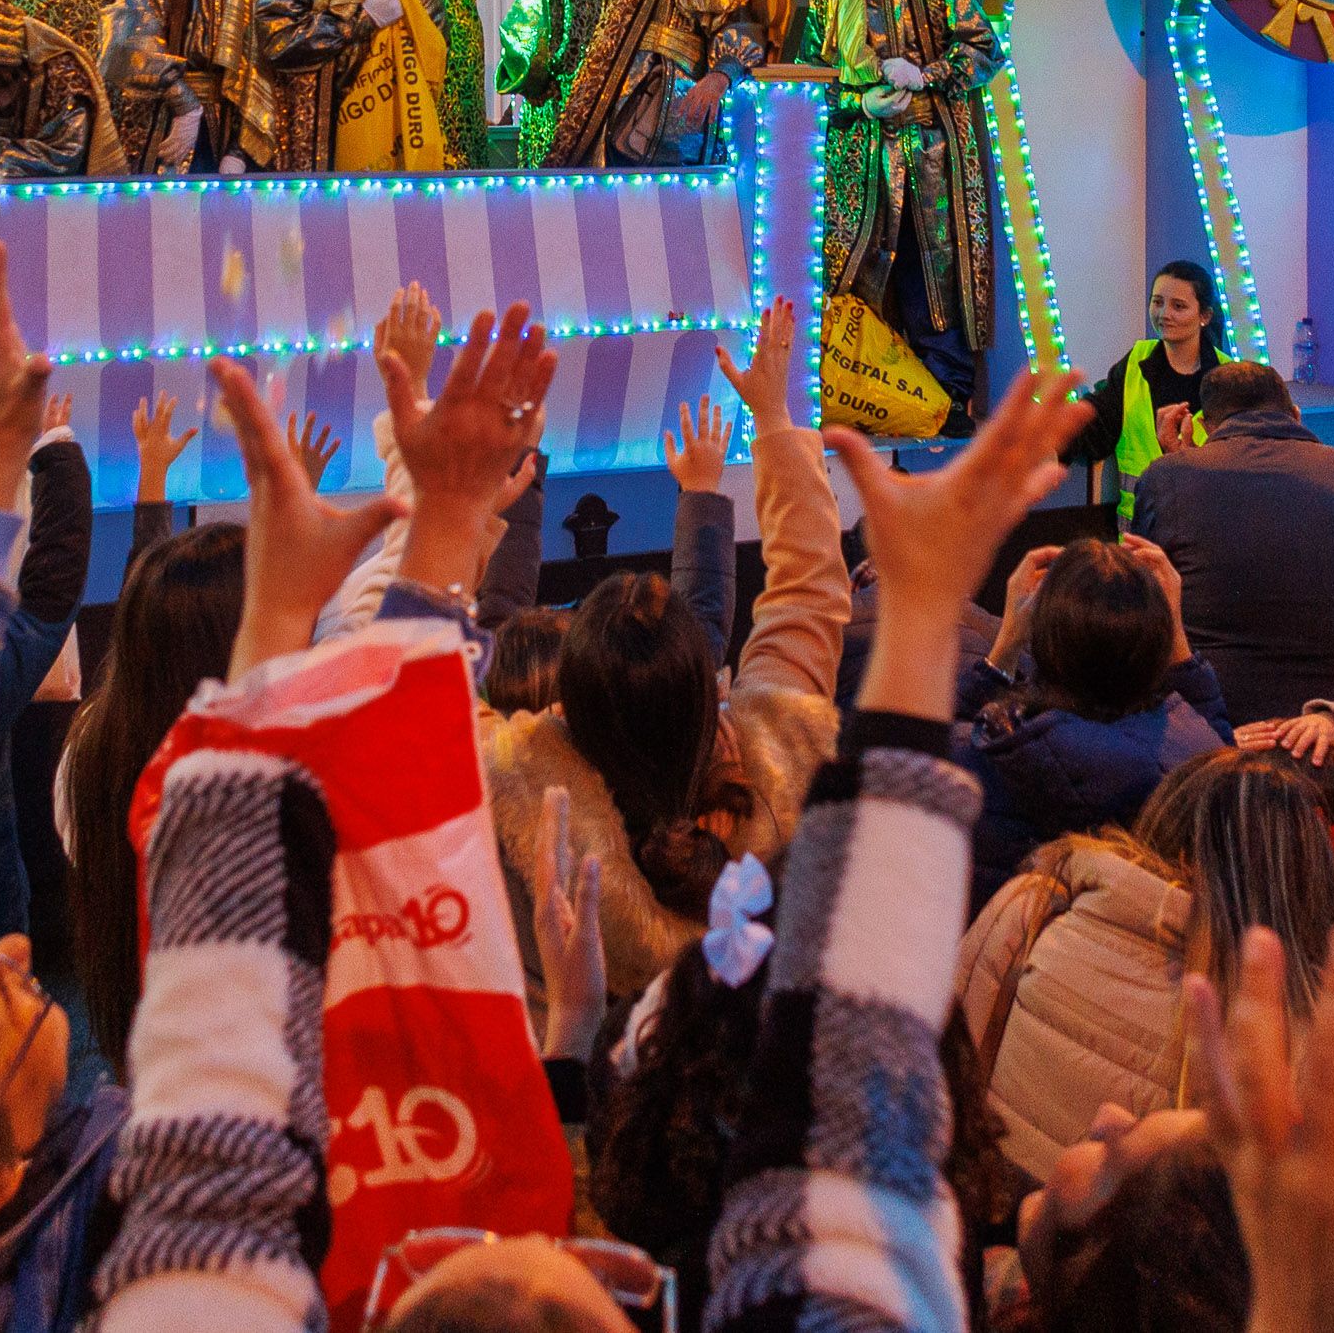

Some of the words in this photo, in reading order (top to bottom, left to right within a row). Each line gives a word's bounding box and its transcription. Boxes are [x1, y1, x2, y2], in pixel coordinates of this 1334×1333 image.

[338, 95, 376, 126] IGO
[406, 93, 424, 149] DURO
[896, 378, 928, 402] S.A.
[838, 391, 889, 420] DURO
